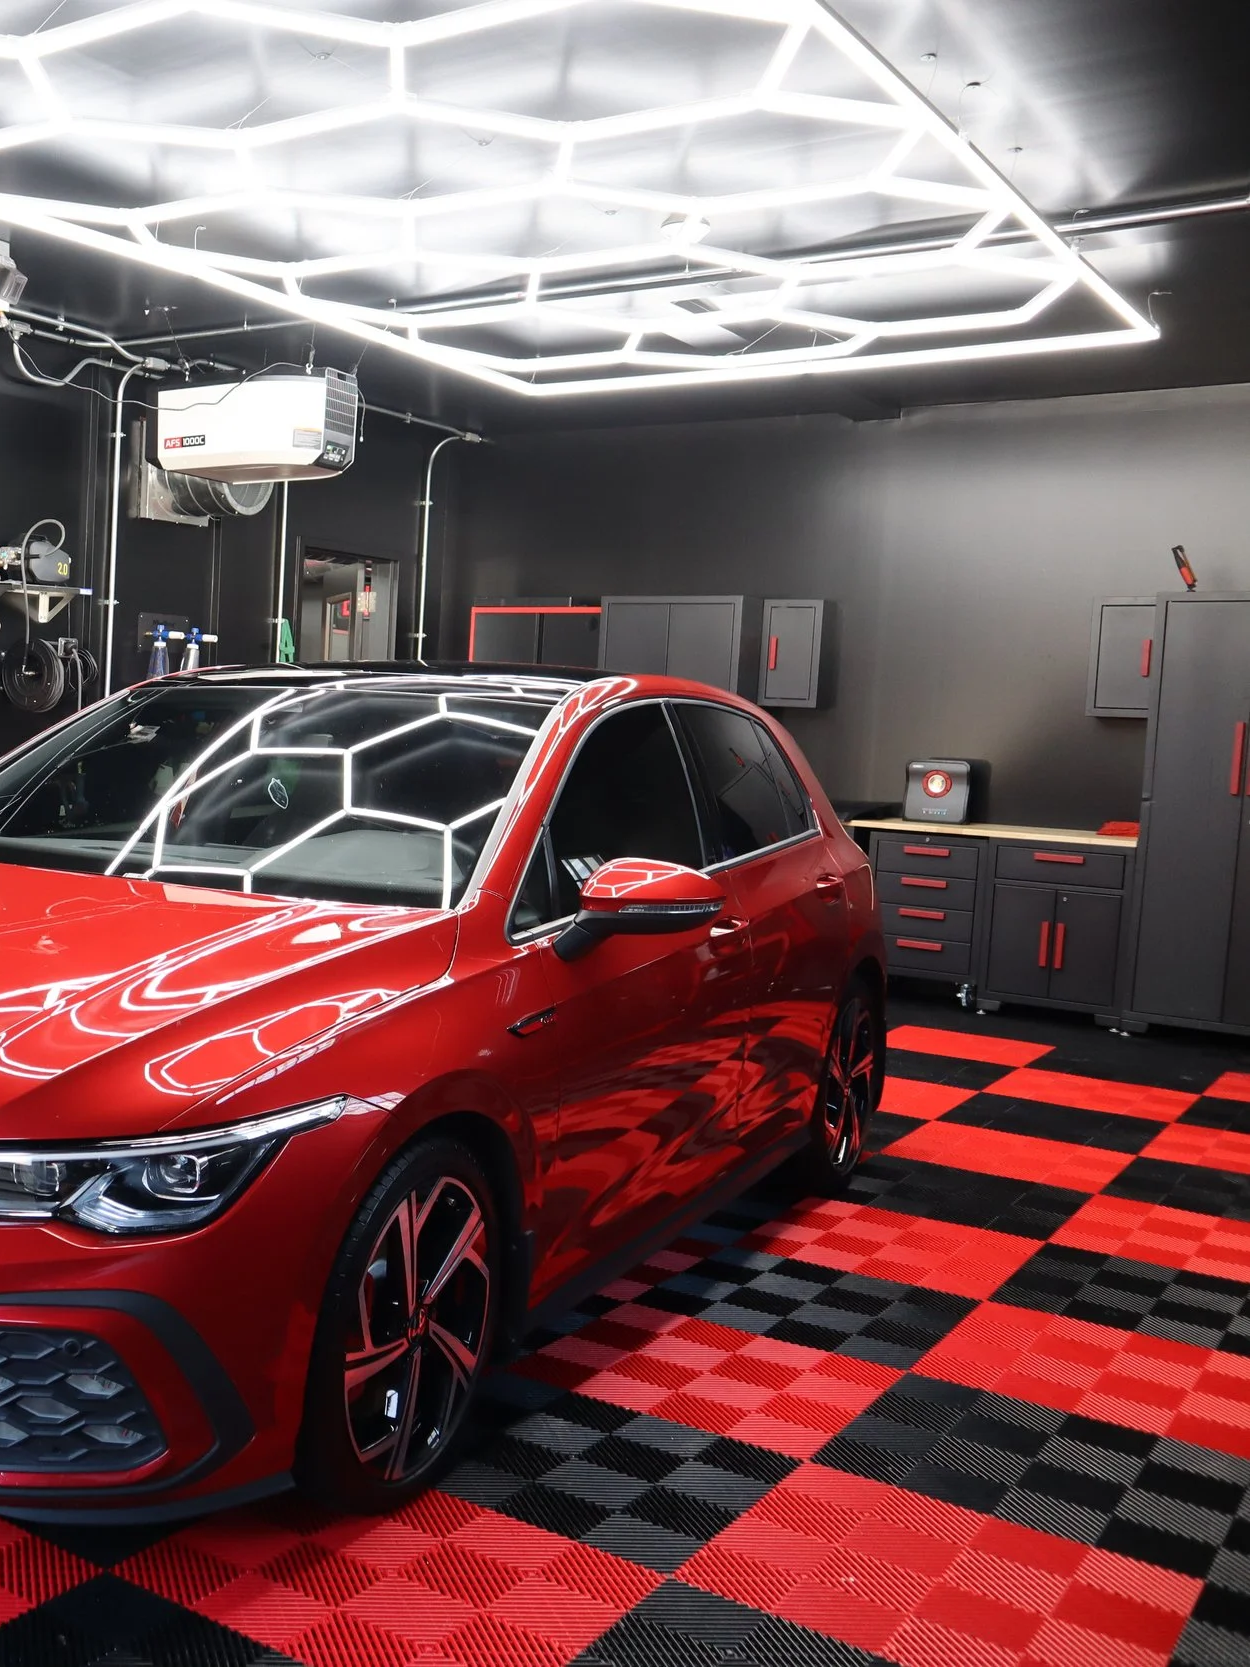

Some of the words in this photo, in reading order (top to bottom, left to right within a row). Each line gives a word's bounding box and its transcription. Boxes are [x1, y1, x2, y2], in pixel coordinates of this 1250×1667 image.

[165, 437, 181, 448] AFS
[182, 435, 205, 446] 1000C
[57, 562, 68, 576] 2.0
